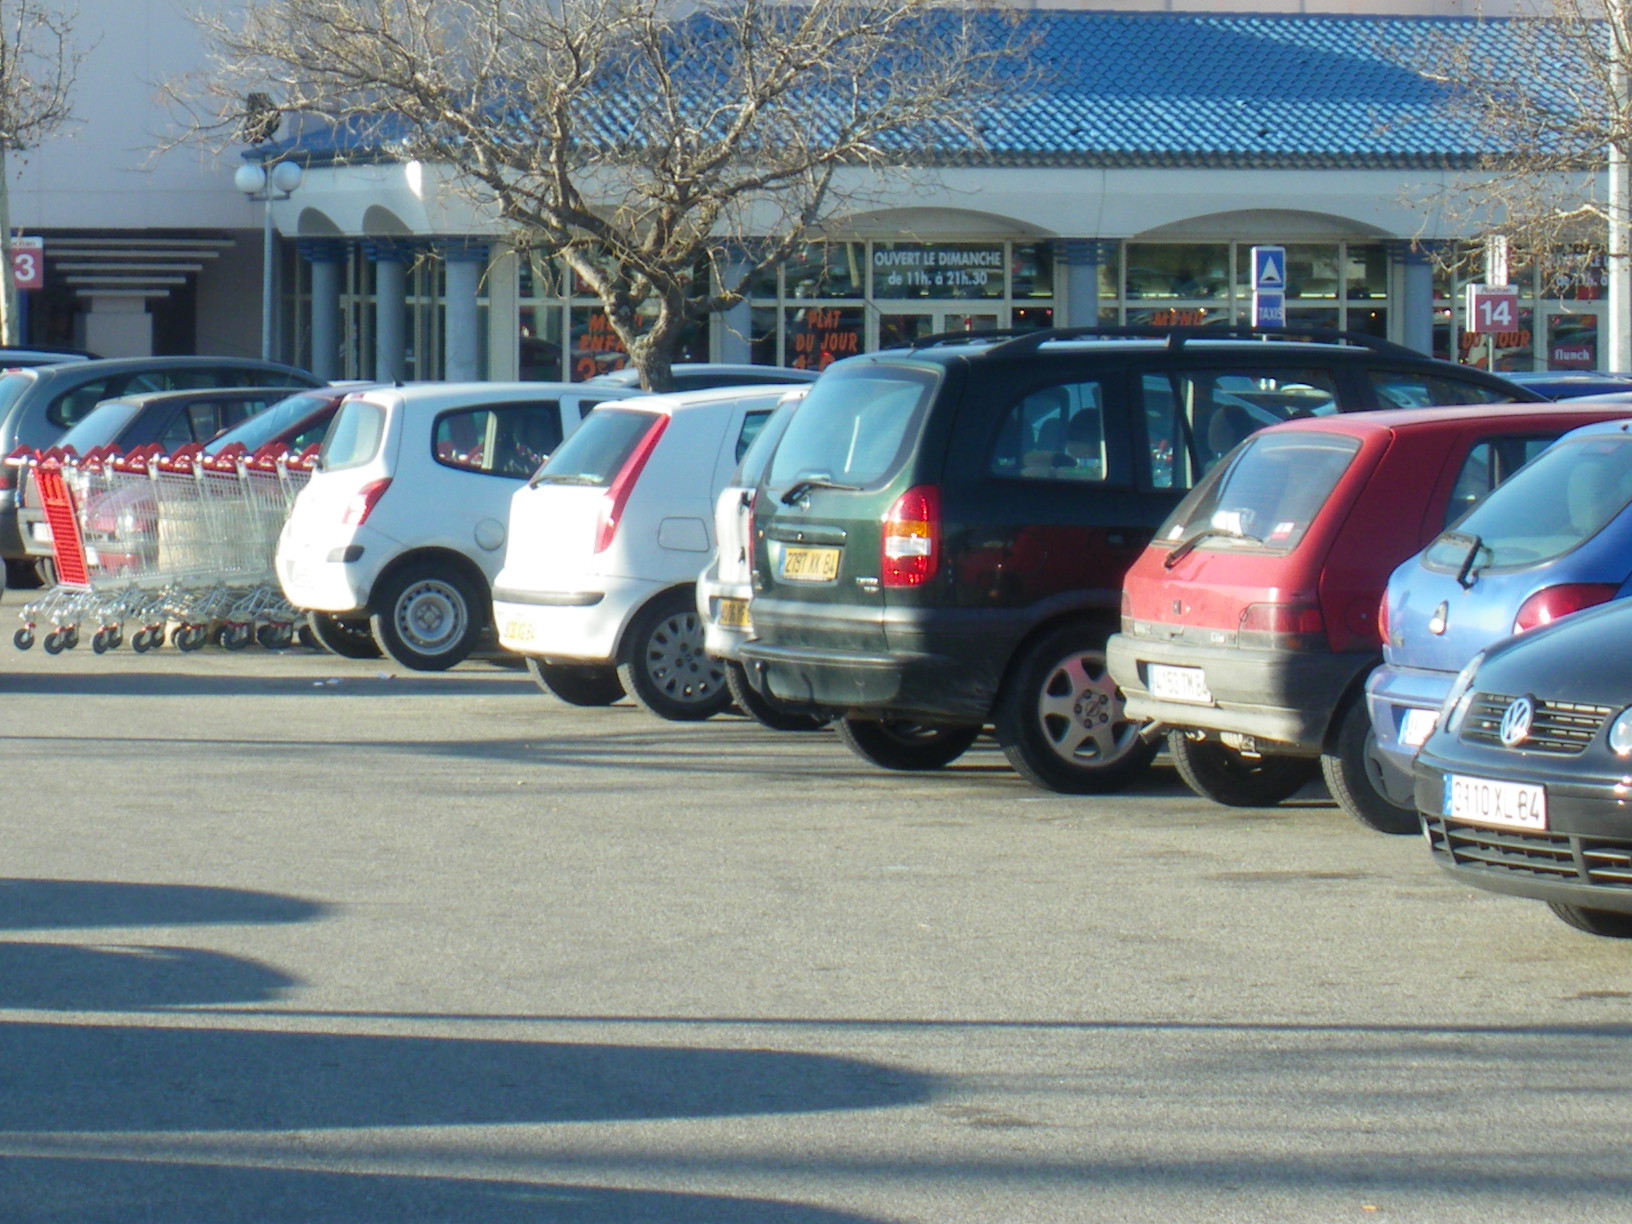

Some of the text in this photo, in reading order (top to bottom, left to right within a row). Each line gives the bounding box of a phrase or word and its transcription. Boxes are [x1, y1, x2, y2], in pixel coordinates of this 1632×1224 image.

[874, 251, 1002, 266] OUVERT LE DIMANCHE
[888, 271, 903, 286] de
[1258, 306, 1283, 321] TAXIS
[1479, 299, 1512, 326] 14
[795, 332, 857, 352] DU JOUR
[1554, 348, 1590, 362] flunch
